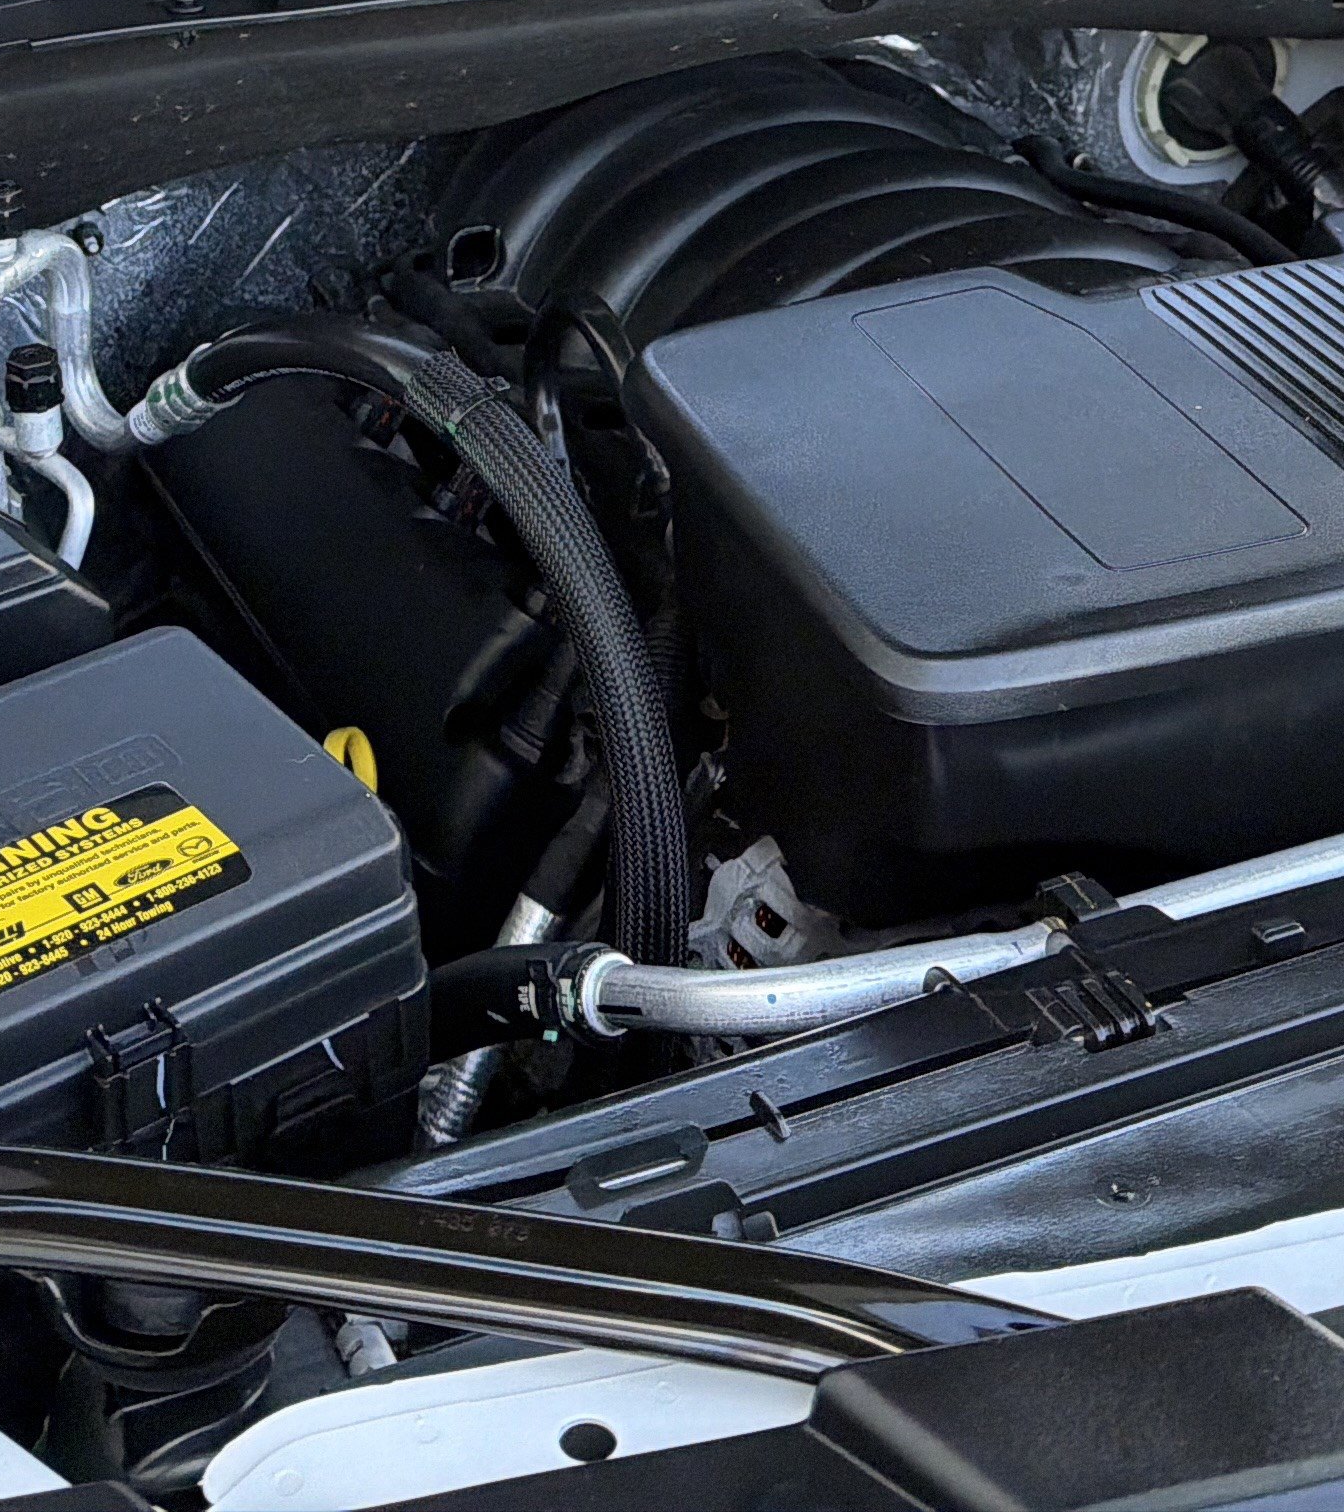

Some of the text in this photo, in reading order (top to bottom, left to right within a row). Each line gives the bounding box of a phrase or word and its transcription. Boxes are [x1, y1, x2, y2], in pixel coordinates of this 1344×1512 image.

[54, 817, 144, 861] SYSTEMS
[0, 899, 16, 913] for
[17, 882, 56, 902] factory
[56, 856, 112, 886] authorized
[112, 842, 150, 864] service
[150, 831, 171, 846] and
[170, 820, 202, 838] parts.
[27, 878, 41, 890] by
[41, 852, 100, 882] unqualified
[126, 862, 163, 884] Ford
[42, 929, 74, 949] 1-920
[79, 904, 129, 934] 923-8444
[145, 863, 223, 903] 1-800-236-4123
[72, 887, 101, 907] GM
[18, 947, 69, 976] 923-8445
[96, 928, 111, 941] 24
[111, 916, 137, 935] Hour
[137, 900, 175, 923] Towing
[517, 985, 531, 1013] PIPE
